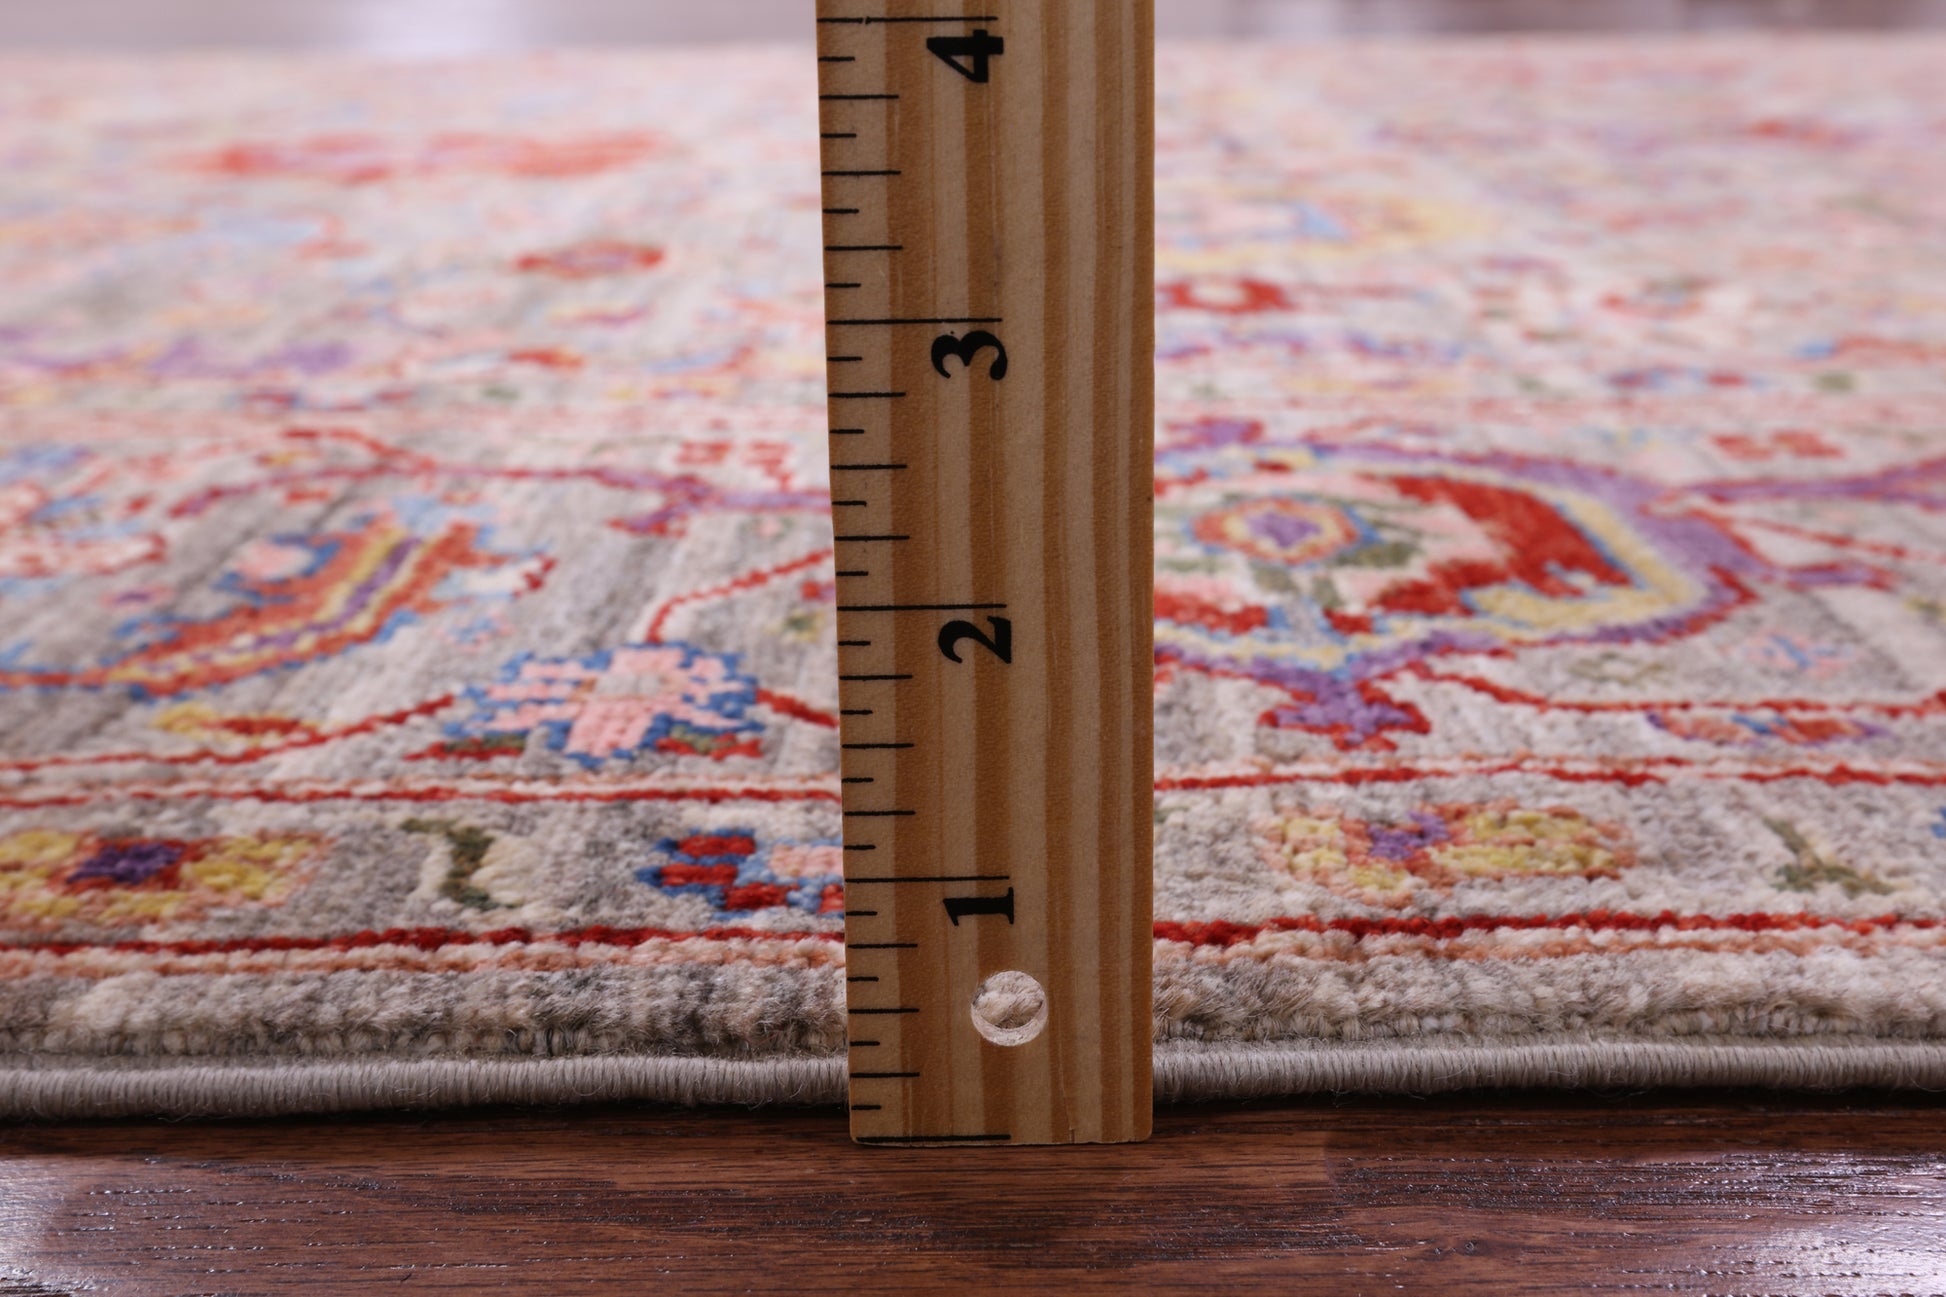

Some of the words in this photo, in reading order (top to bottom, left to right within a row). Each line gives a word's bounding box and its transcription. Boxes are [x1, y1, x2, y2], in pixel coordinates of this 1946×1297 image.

[926, 29, 1004, 84] 4
[930, 330, 1008, 381] 3
[937, 614, 1012, 665] 2
[942, 886, 1015, 927] 1
